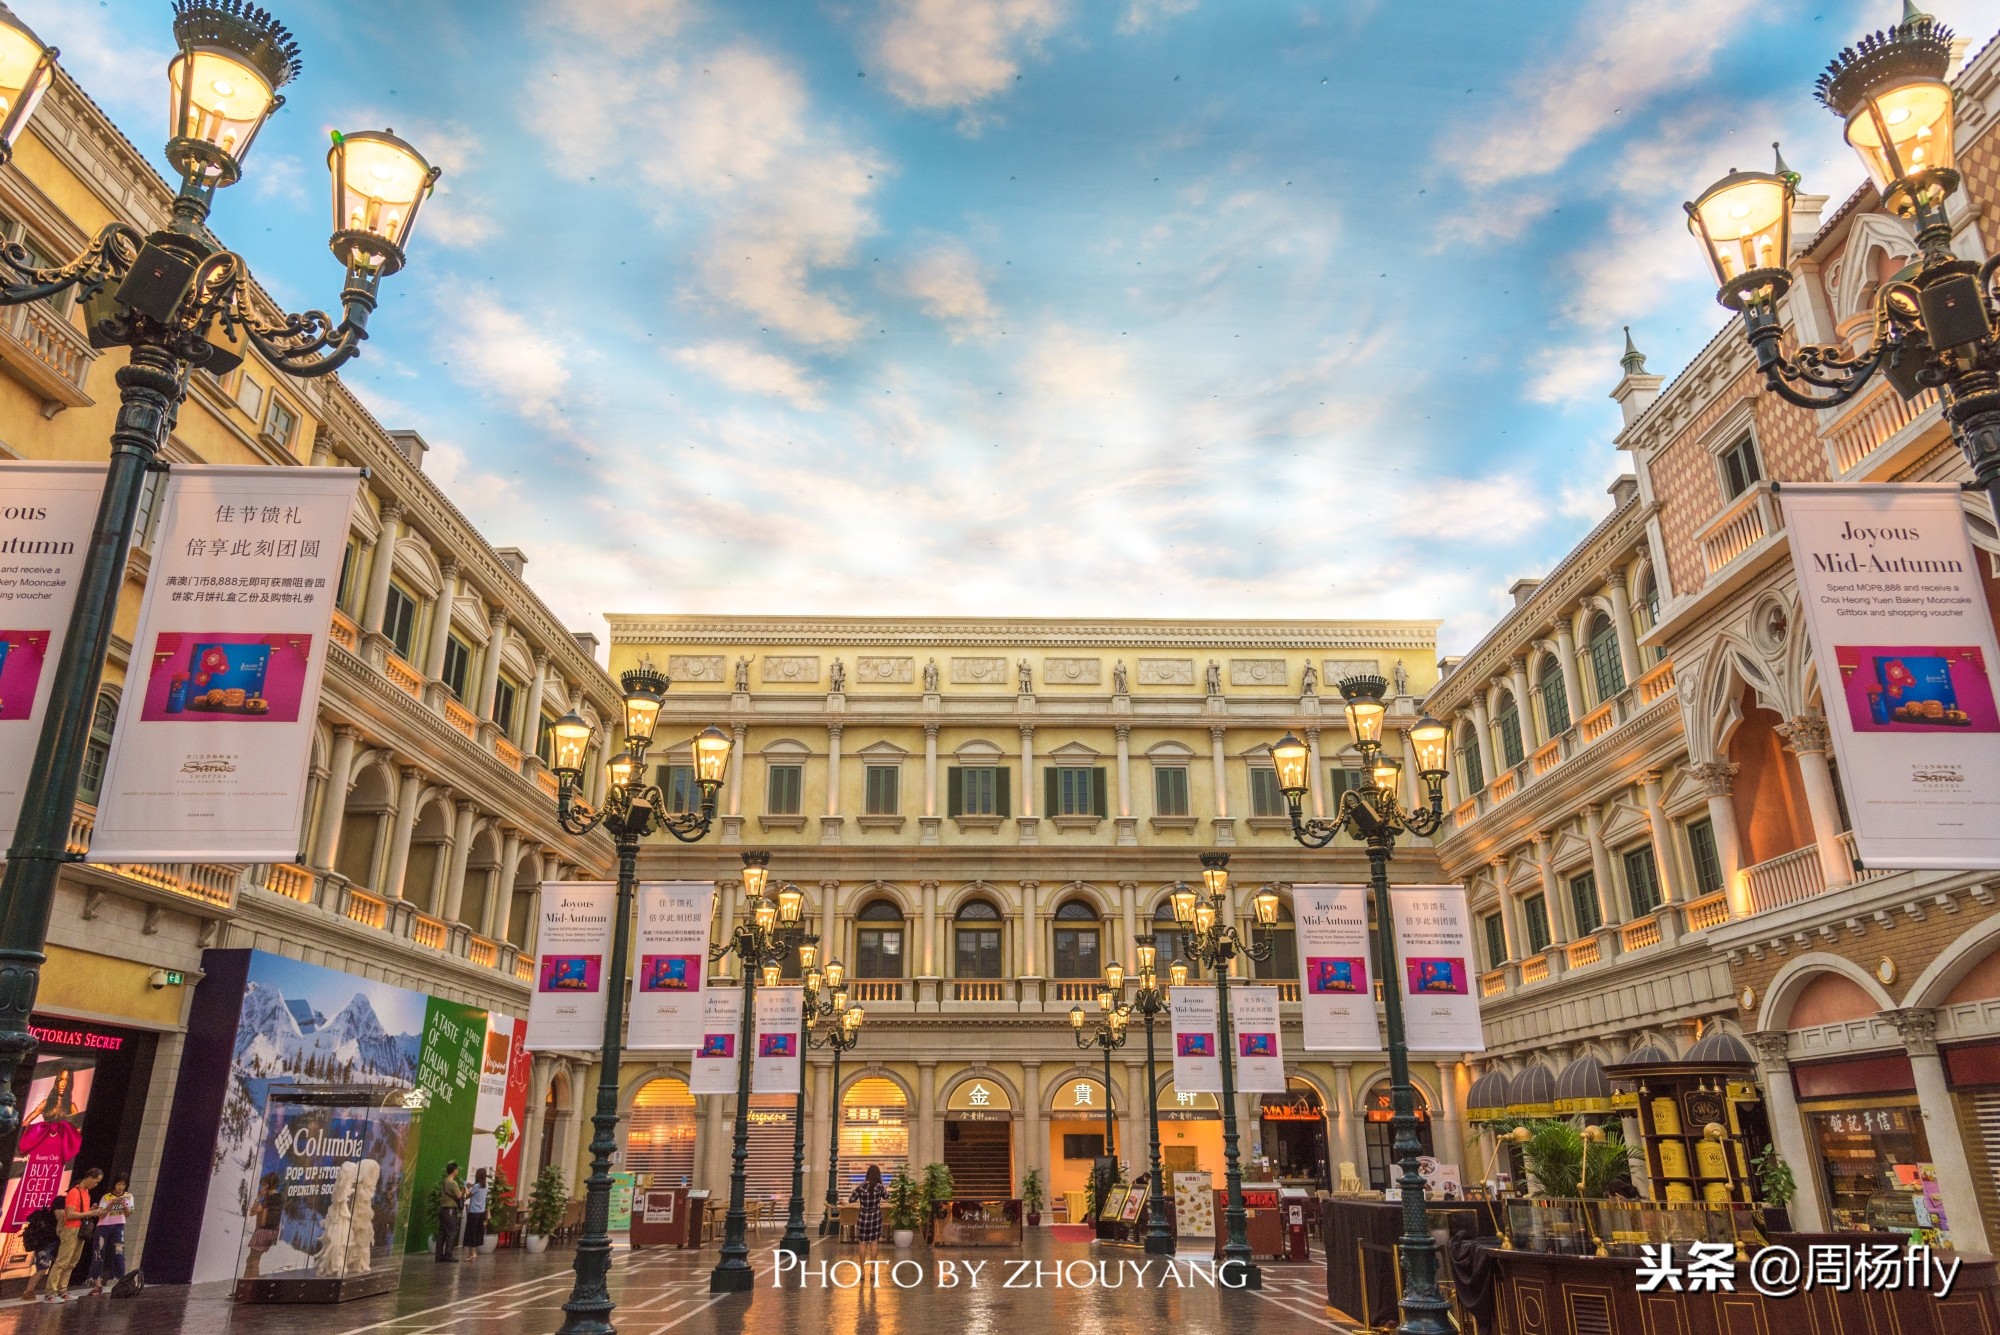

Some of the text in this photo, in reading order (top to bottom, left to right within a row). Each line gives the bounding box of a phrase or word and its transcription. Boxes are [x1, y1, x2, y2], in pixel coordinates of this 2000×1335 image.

[215, 504, 302, 524] 佳节馈礼
[1840, 521, 1920, 548] Joyous
[186, 538, 321, 558] 倍享此刻团圆
[1813, 553, 1964, 573] Mid-Autumn
[1, 566, 18, 574] and
[20, 566, 53, 574] receive
[20, 579, 66, 587] Mooncake
[1826, 583, 1855, 593] Spend
[1903, 584, 1919, 592] and
[1921, 584, 1952, 592] receive
[16, 592, 52, 600] voucher
[171, 591, 315, 604] 饼家月饼礼盒乙份及购物礼券
[1820, 596, 1972, 606] Choi Heong Yuen Bakery Mooncake
[1836, 608, 1964, 618] Giftbox and shopping voucher
[560, 898, 594, 911] Joyous
[1314, 901, 1347, 914] Joyous
[546, 913, 607, 923] Mid-Autumn
[1302, 915, 1363, 926] Mid-Autumn
[1182, 997, 1203, 1006] Joyous
[432, 1010, 460, 1045] A TASTE
[84, 1033, 123, 1050] SECRET
[428, 1028, 441, 1047] OF
[468, 1029, 481, 1048] TASTE
[423, 1045, 450, 1079] ITALIAN
[968, 1083, 990, 1106] 金
[1073, 1083, 1093, 1106] 貴
[1263, 1105, 1320, 1116] MADEIRA
[293, 1128, 363, 1157] Columbia
[30, 1164, 60, 1178] BUY 2
[285, 1166, 304, 1180] POP
[304, 1166, 318, 1180] UP
[26, 1178, 56, 1191] GET 1
[287, 1184, 320, 1197] OPENING
[22, 1192, 53, 1208] FREE
